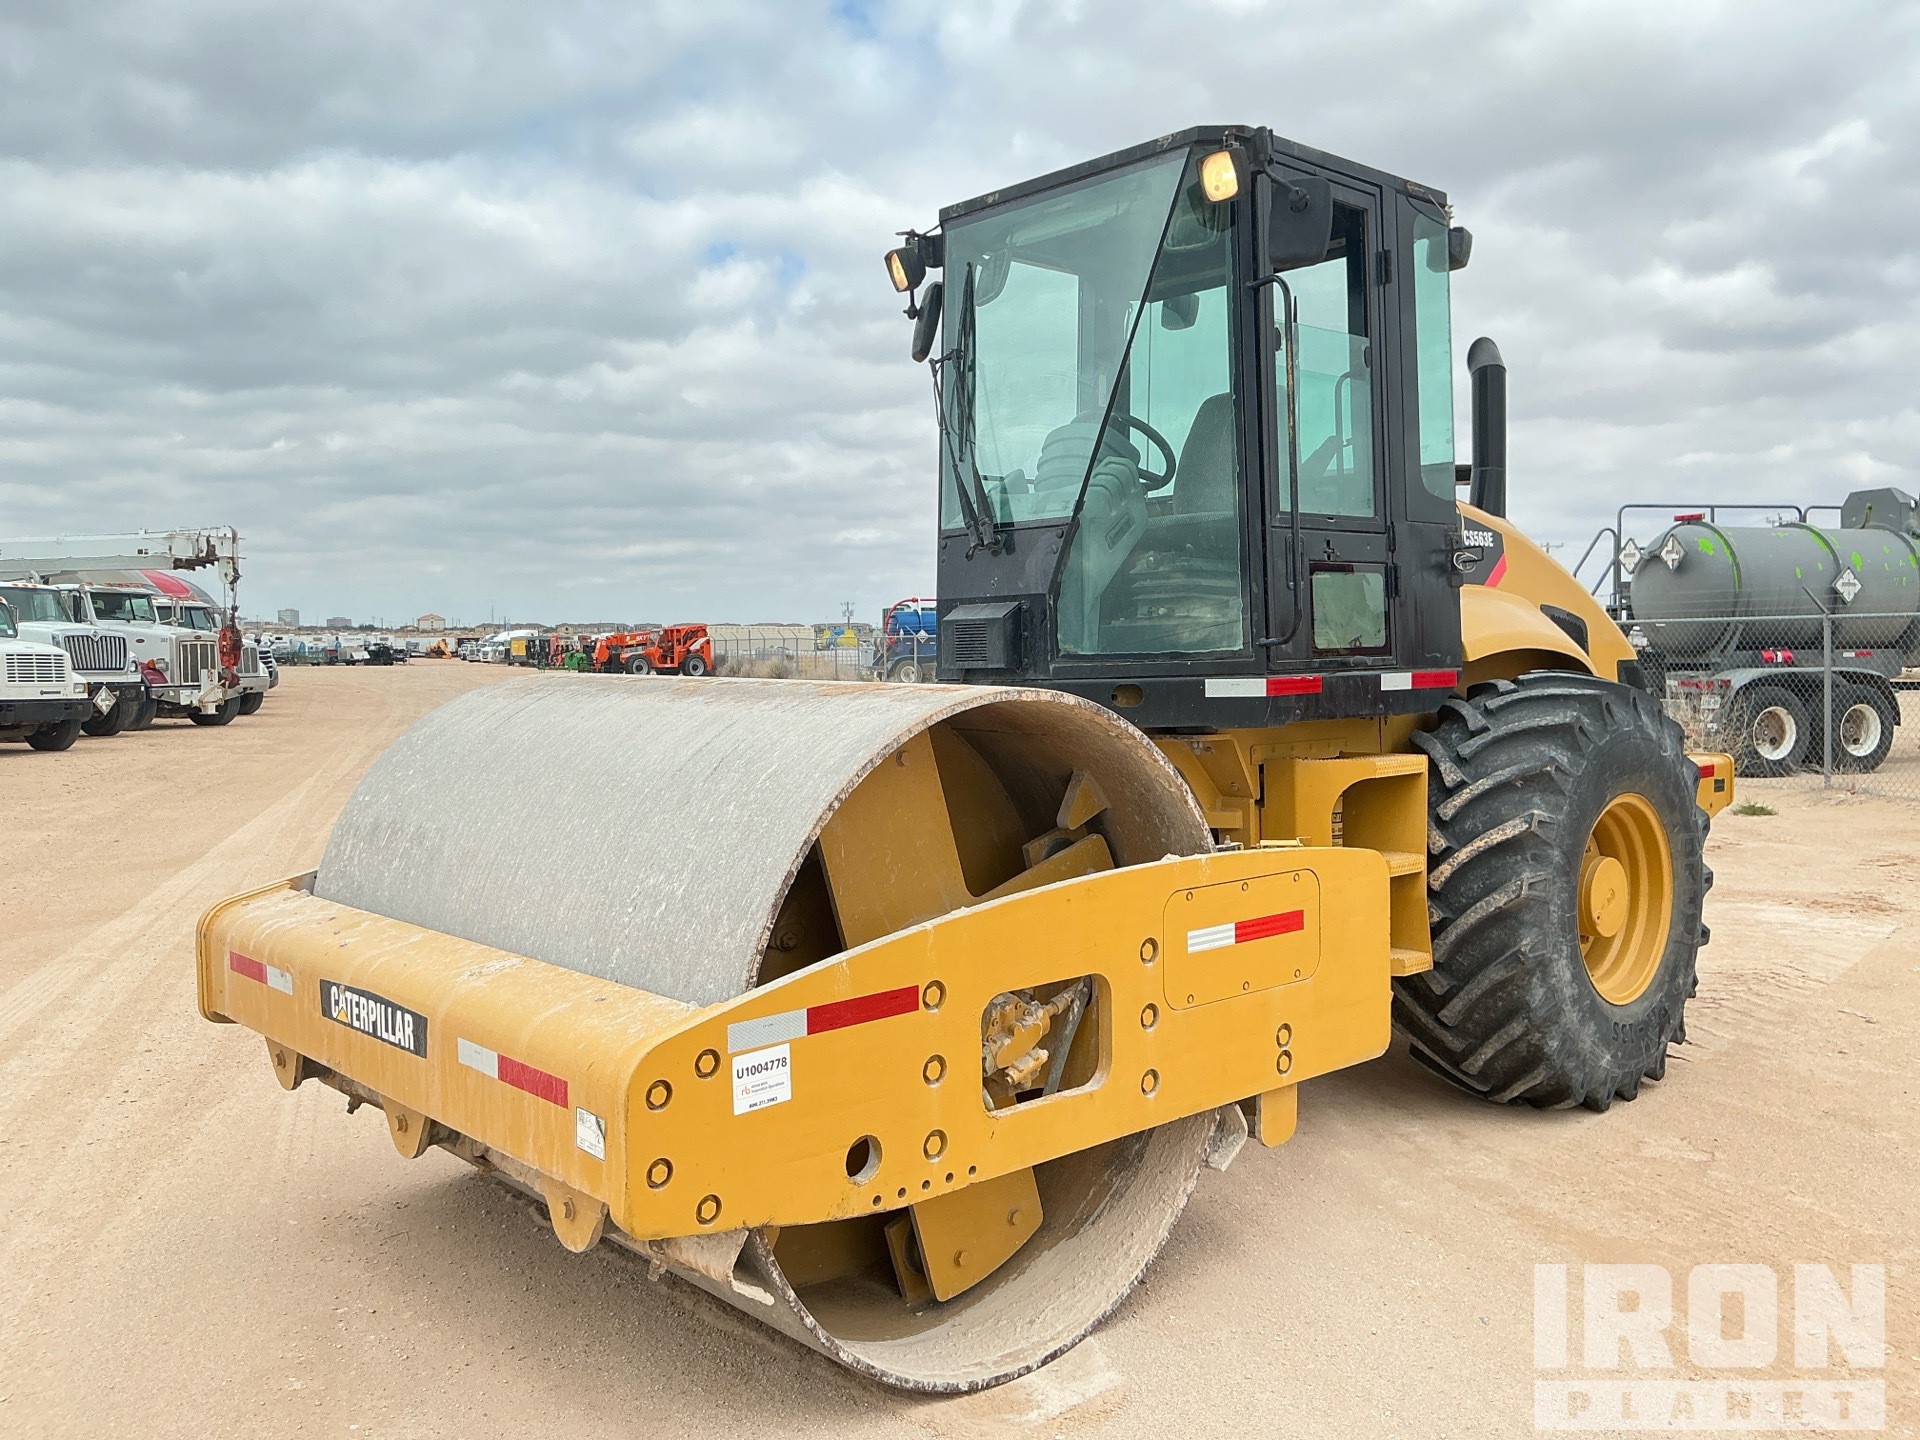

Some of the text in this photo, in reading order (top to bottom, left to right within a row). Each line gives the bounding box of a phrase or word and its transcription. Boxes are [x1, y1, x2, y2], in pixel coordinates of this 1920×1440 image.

[1463, 530, 1494, 547] CS563E
[330, 985, 415, 1050] CATERPILLAR
[736, 1057, 788, 1079] U1004778
